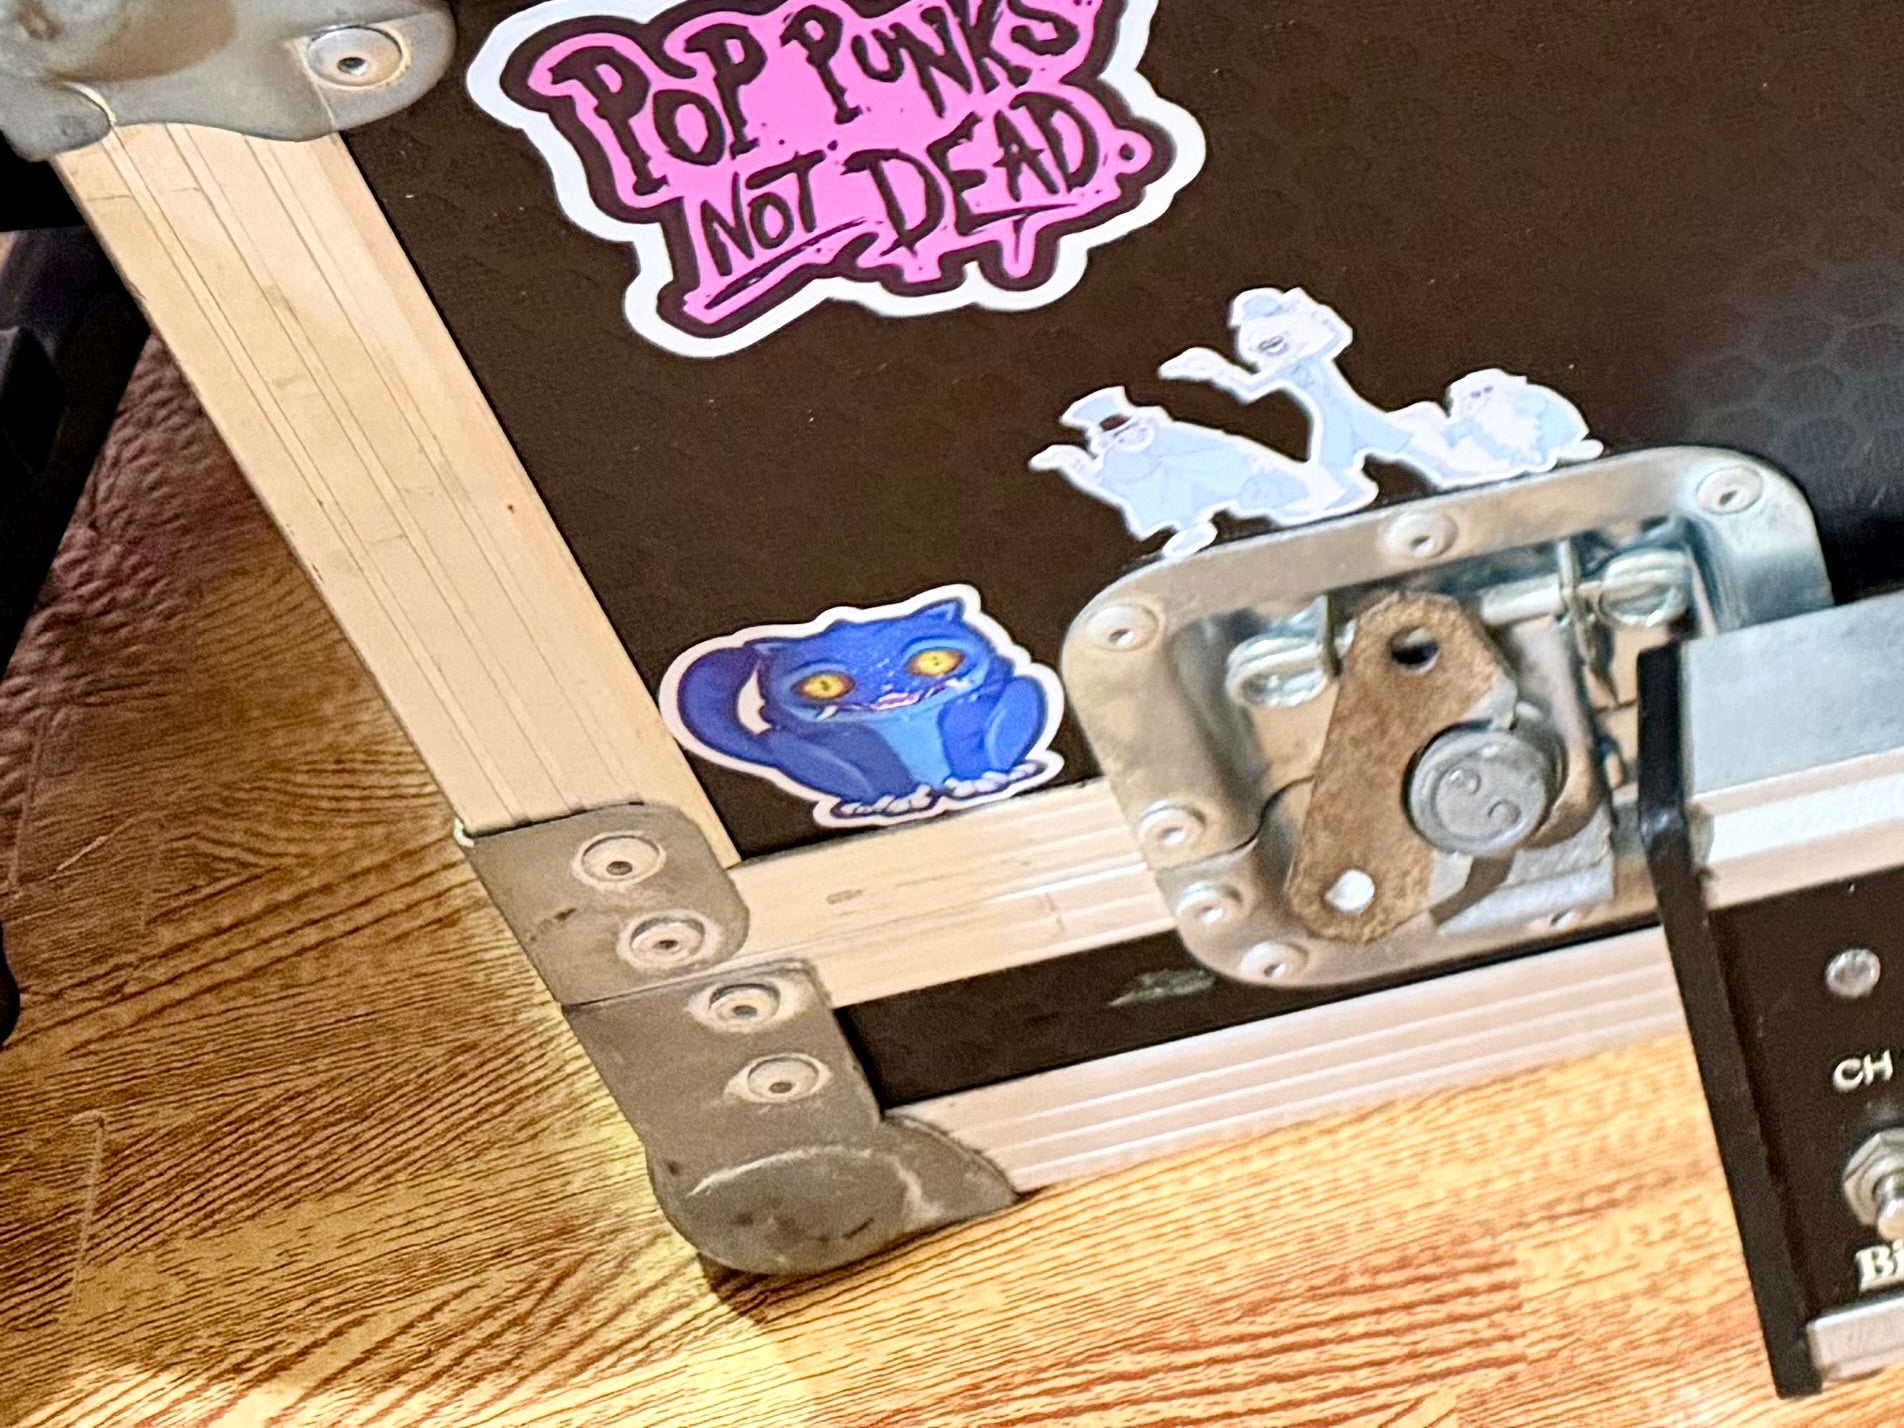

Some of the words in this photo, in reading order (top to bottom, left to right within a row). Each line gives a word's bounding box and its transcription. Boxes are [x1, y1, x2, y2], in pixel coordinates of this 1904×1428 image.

[551, 22, 767, 196] POP
[844, 92, 1100, 257] DEAD
[1832, 1051, 1893, 1093] CH
